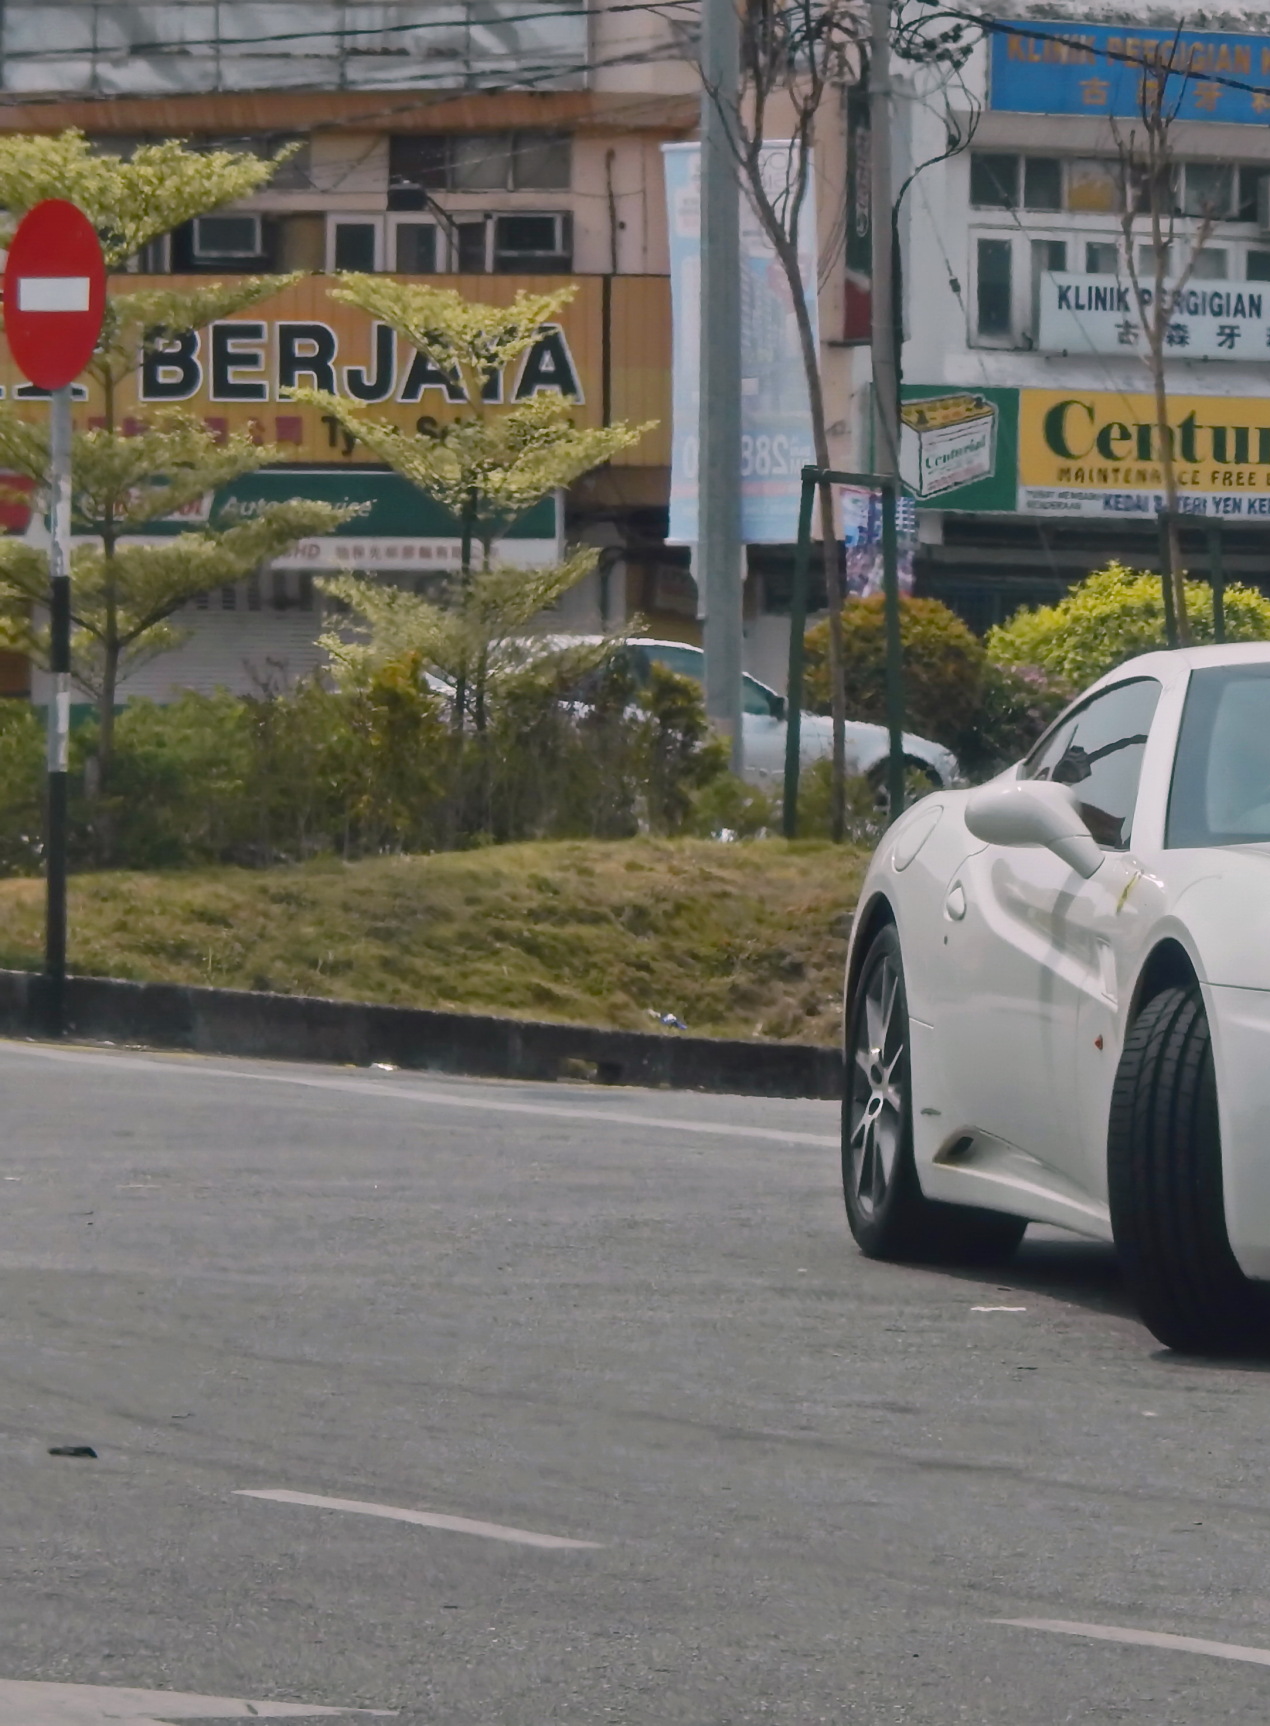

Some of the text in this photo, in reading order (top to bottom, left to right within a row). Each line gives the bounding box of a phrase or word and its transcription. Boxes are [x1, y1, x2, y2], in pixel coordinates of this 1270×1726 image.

[1007, 33, 1096, 65] KLINIK
[1058, 285, 1129, 312] KLINIK
[1057, 467, 1200, 486] MAINTENACE
[1211, 470, 1257, 487] FREE
[1153, 494, 1208, 515] BTERI
[1212, 496, 1243, 514] YEN
